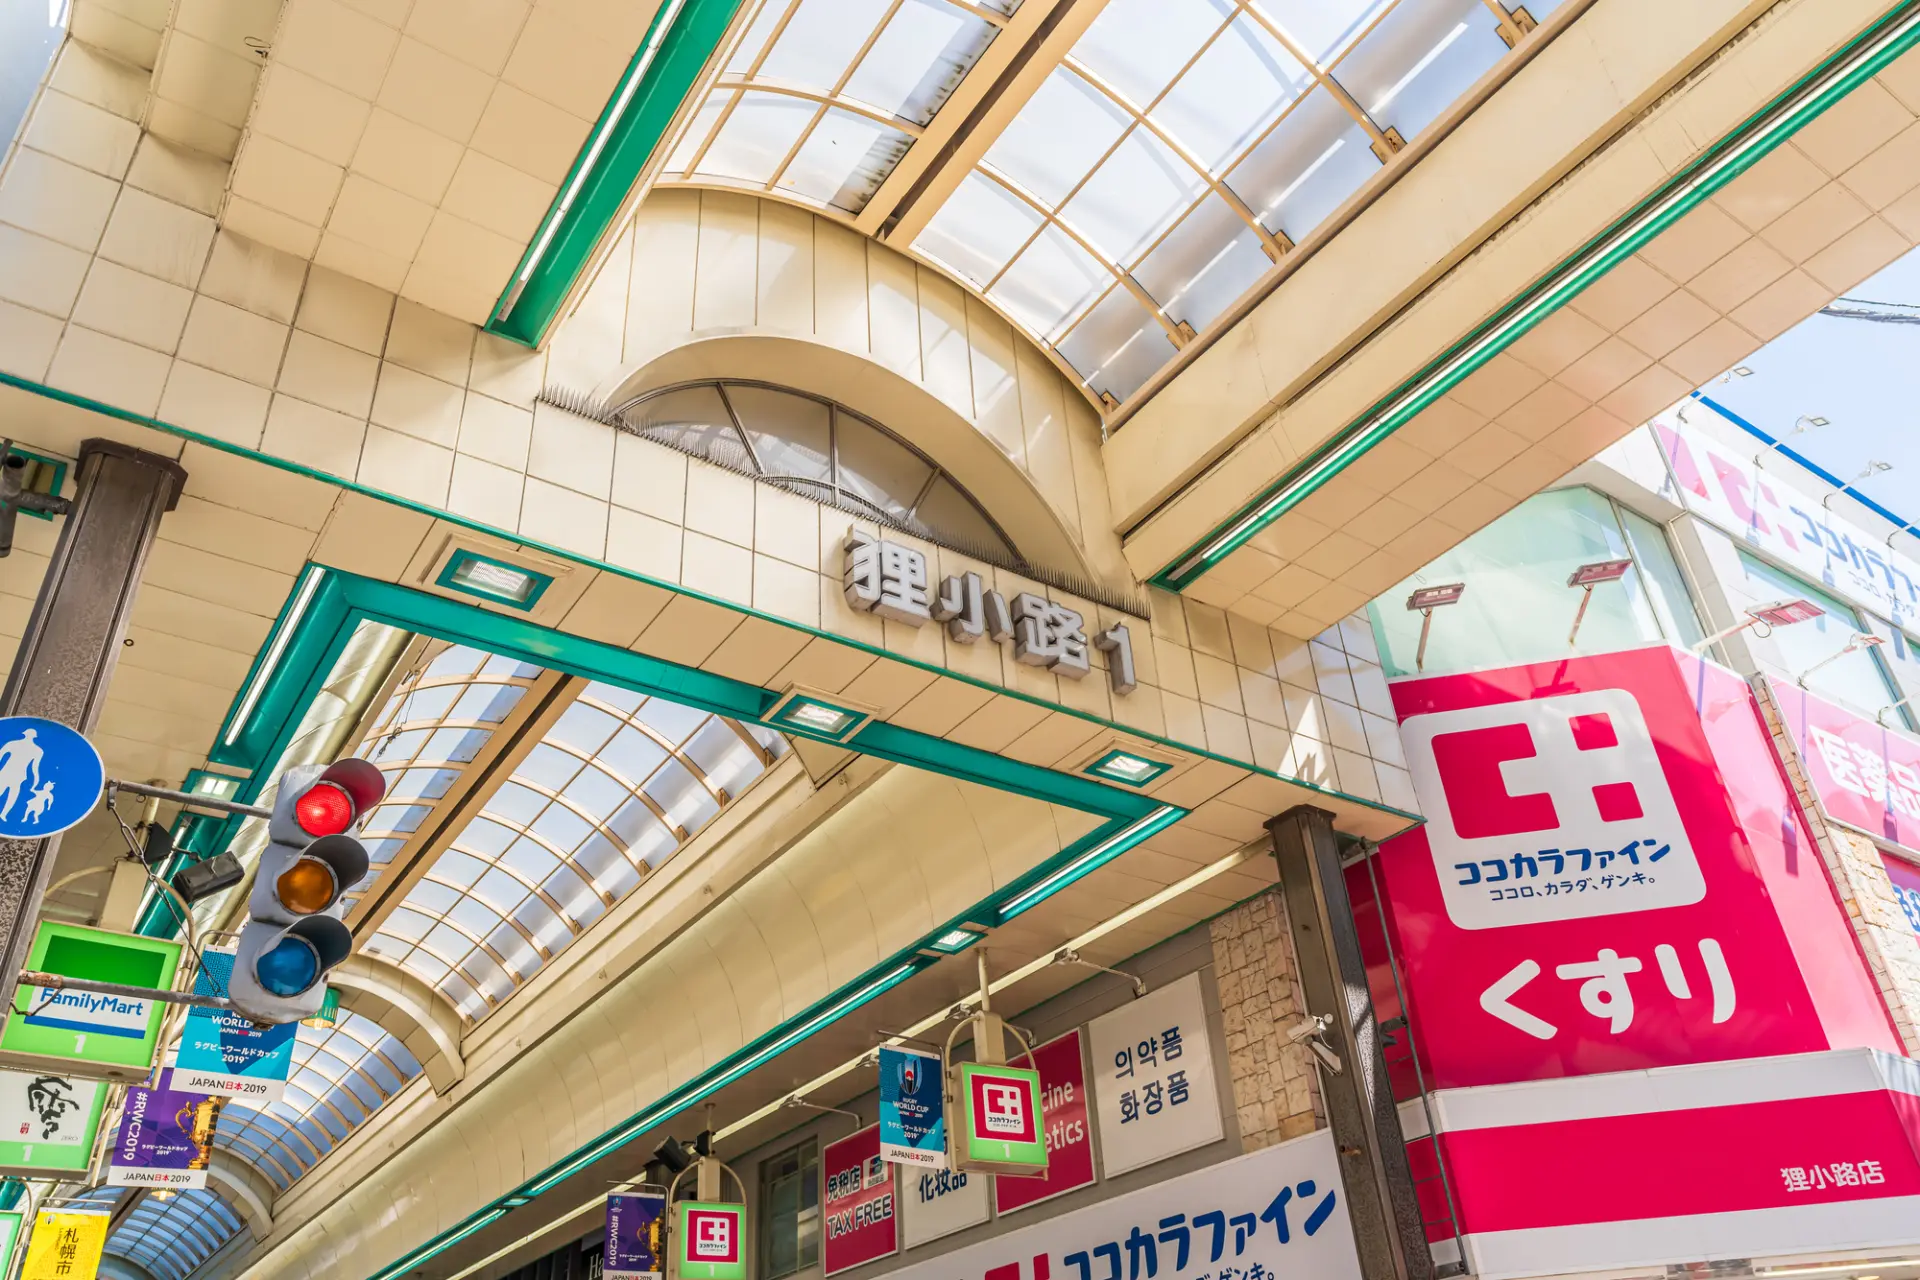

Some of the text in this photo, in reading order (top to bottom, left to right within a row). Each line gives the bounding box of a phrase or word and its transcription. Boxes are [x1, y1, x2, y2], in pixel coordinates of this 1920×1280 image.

[1789, 504, 1920, 603] ココカラフ
[843, 523, 1137, 695] 狸小路1
[1454, 838, 1671, 886] ココカラファイン
[1489, 872, 1656, 901] ココロ、カラダ、ゲンキ。
[40, 987, 144, 1016] FamilyMart
[1479, 938, 1736, 1040] くすり
[74, 1034, 86, 1054] 1
[195, 1041, 280, 1059] ラグビーワールドカップ
[1115, 1026, 1183, 1079] 의약품
[189, 1077, 267, 1095] JAPAN日本2019
[892, 1100, 930, 1113] WORLD CUP
[1119, 1070, 1189, 1124] 화장품
[123, 1091, 148, 1161] #RWC2019
[23, 1144, 34, 1162] 1
[1001, 1143, 1011, 1158] 1
[123, 1172, 191, 1183] JAPAN日本2019
[1780, 1160, 1886, 1192] 狸小路店
[827, 1193, 893, 1240] TAX FREE
[1064, 1179, 1336, 1280] ココカラファイン
[55, 1227, 80, 1275] 札幌市
[610, 1215, 619, 1266] #RWC2019
